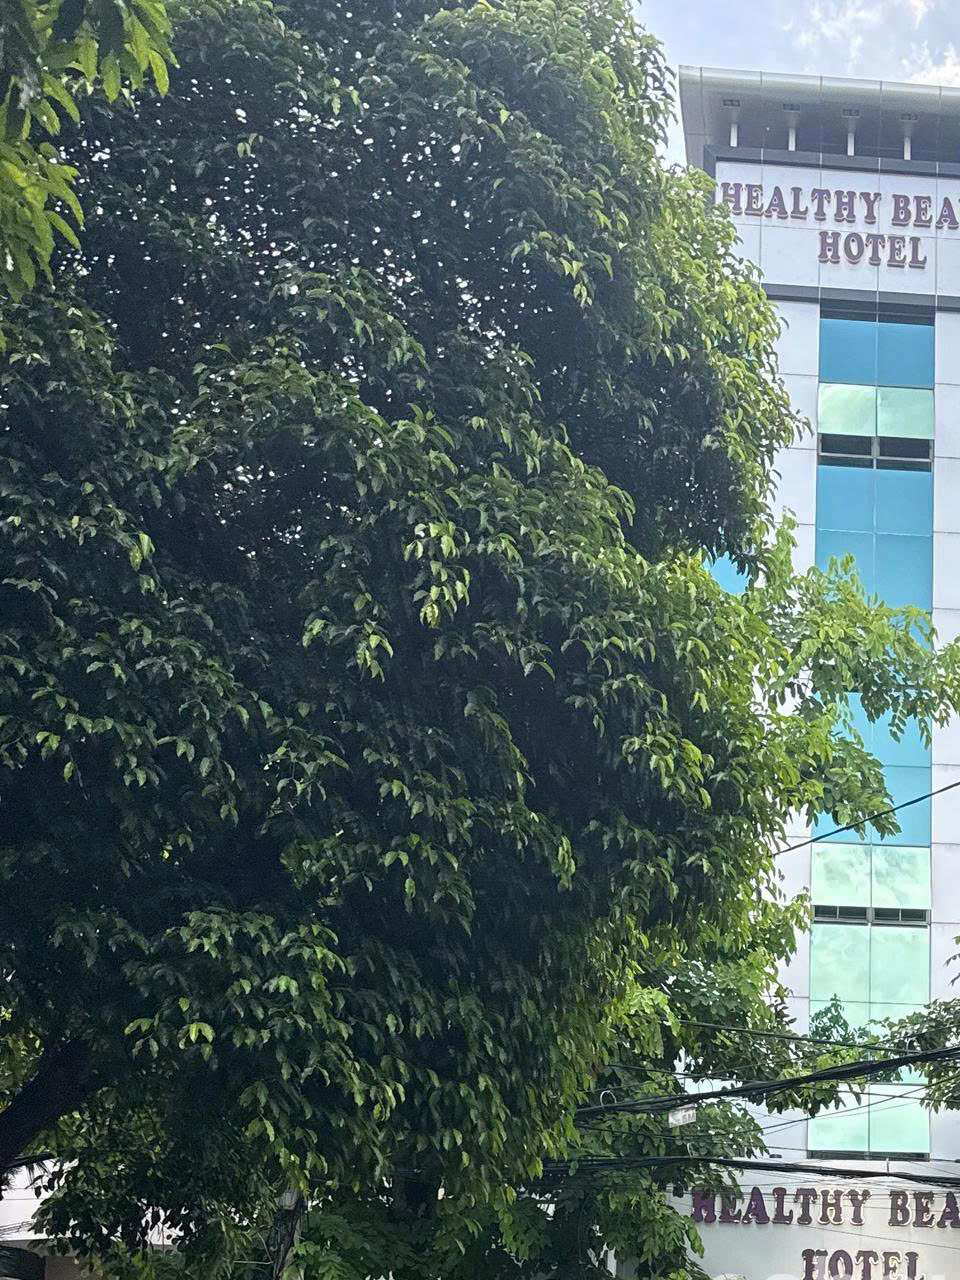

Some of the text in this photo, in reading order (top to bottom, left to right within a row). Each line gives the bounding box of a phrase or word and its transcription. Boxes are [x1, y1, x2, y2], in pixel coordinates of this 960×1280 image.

[720, 182, 882, 224] HEALTHY
[818, 231, 928, 268] HOTEL
[691, 1186, 872, 1226] HEALTHY
